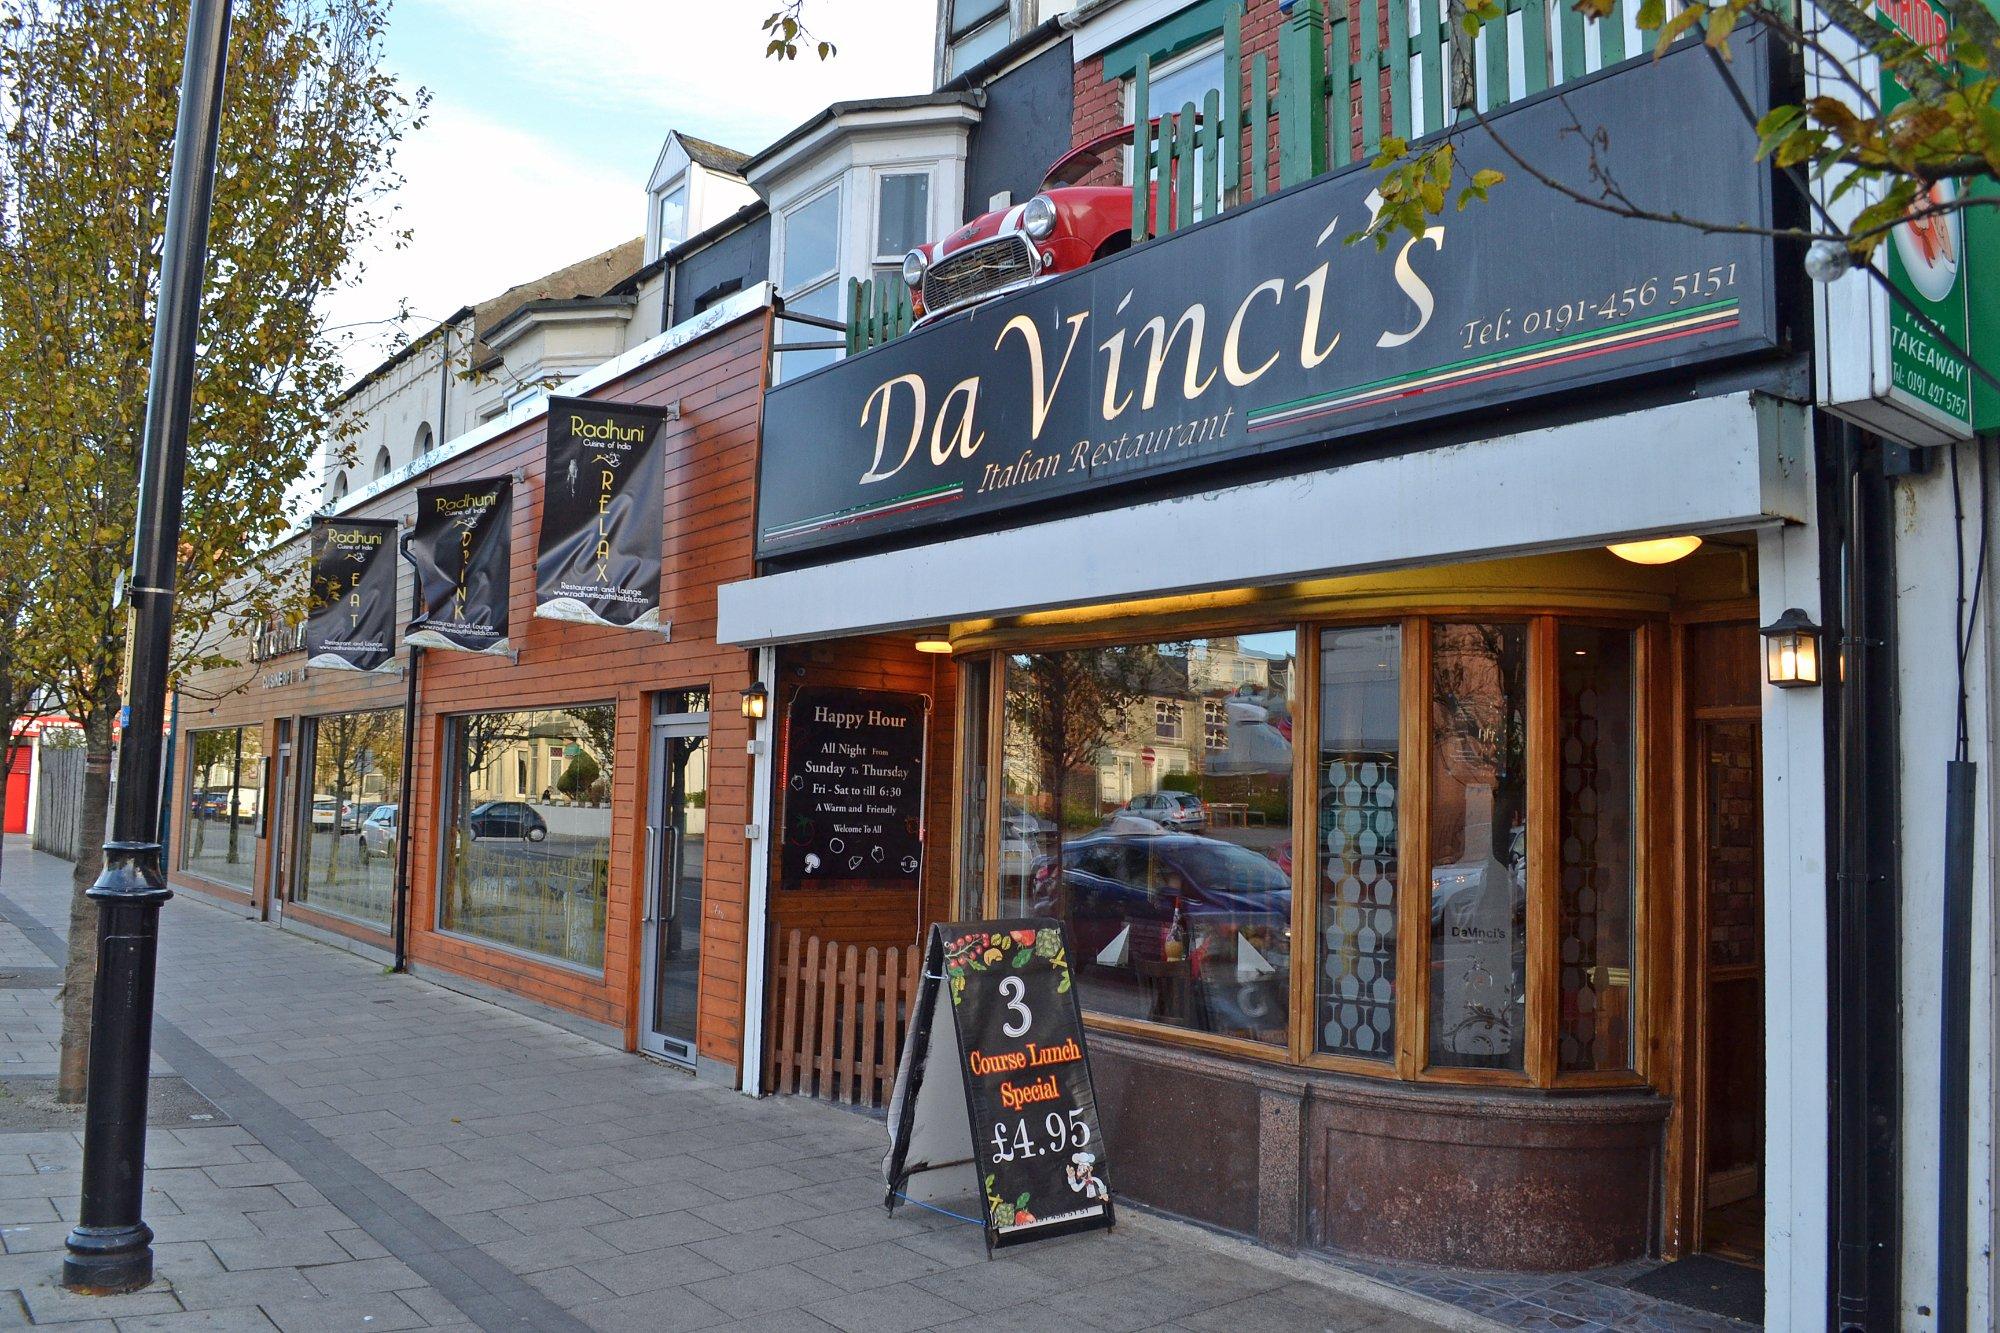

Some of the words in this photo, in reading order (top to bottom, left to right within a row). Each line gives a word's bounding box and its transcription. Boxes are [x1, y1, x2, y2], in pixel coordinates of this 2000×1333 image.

[1460, 308, 1512, 349] Tel:
[1523, 277, 1659, 333] 0191-456
[1669, 263, 1737, 305] 5151
[1892, 325, 1965, 383] TAKEAWAY
[1893, 362, 1905, 385] Tel:
[1907, 371, 1926, 396] 0191
[1928, 383, 1945, 405] 427
[1946, 392, 1967, 417] 5757
[570, 415, 645, 442] Radhuni
[583, 439, 606, 448] Cuisine
[607, 441, 615, 449] of
[616, 442, 632, 450] India
[977, 450, 1061, 494] Italian
[1067, 406, 1235, 474] Restaurant
[435, 491, 497, 513] Radhuni
[328, 528, 382, 545] Radhuni
[596, 470, 614, 583] RELAX
[454, 531, 472, 621] DRINK
[351, 572, 360, 628] EAT
[561, 582, 598, 592] Restaurant
[601, 585, 616, 593] and
[617, 586, 642, 597] Lounge
[473, 623, 494, 632] Lounge
[325, 639, 352, 647] Restaurant
[814, 706, 864, 729] Happy
[867, 710, 906, 727] Hour
[821, 743, 835, 753] All
[838, 743, 866, 757] Night
[872, 748, 888, 756] From
[805, 761, 846, 777] Sunday
[850, 767, 859, 775] To
[862, 764, 909, 780] Thursday
[812, 783, 826, 794] Fri
[834, 784, 849, 795] Sat
[851, 787, 860, 795] to
[863, 785, 876, 795] till
[879, 787, 902, 797] 6:30
[815, 803, 822, 812] A
[823, 803, 846, 812] Warm
[848, 804, 862, 812] and
[866, 804, 896, 816] Friendly
[833, 824, 862, 833] Welcome
[863, 825, 872, 833] To
[873, 825, 882, 833] All
[999, 976, 1032, 1038] 3
[970, 1050, 1027, 1076] Course
[1025, 1037, 1082, 1067] Lunch
[1001, 1074, 1060, 1111] Special
[991, 1107, 1091, 1164] £4.95
